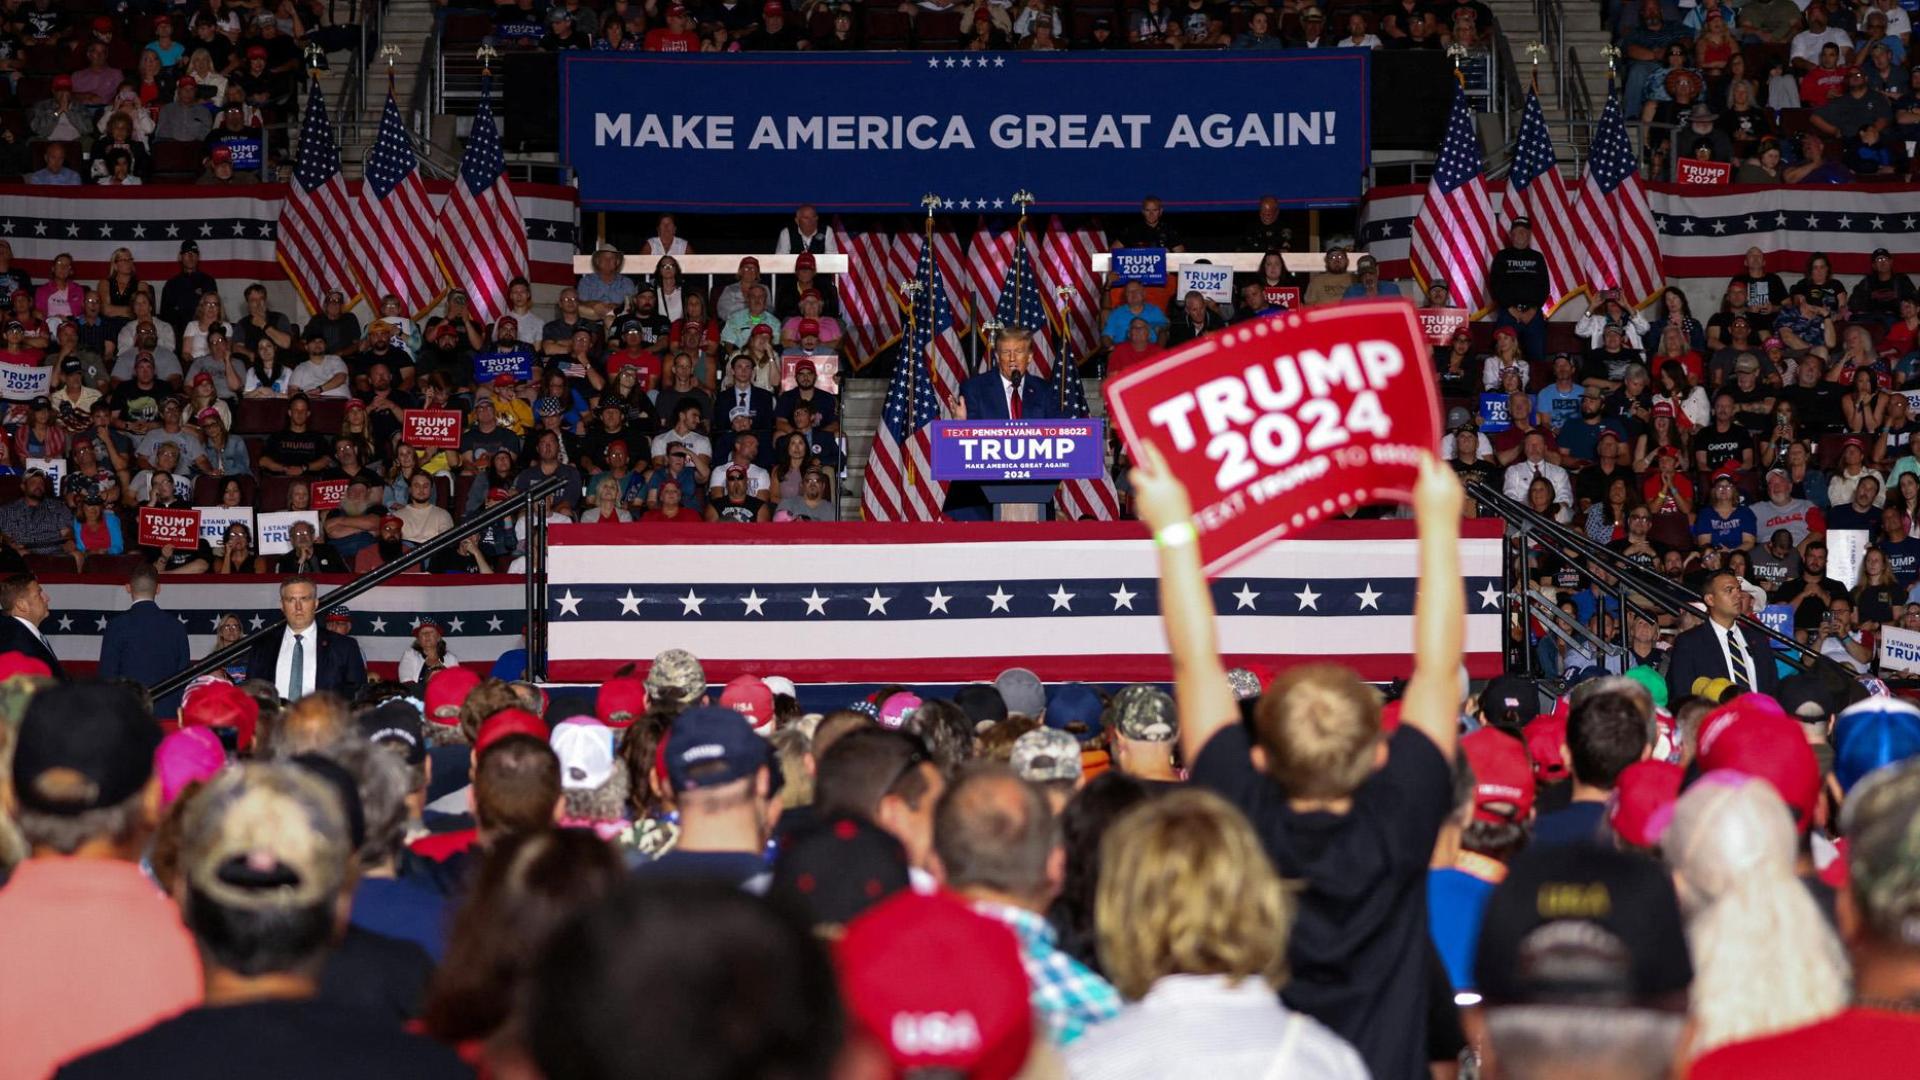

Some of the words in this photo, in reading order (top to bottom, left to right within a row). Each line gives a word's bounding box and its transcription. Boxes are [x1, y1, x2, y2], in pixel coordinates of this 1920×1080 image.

[595, 112, 734, 150] MAKE
[748, 114, 975, 150] AMERICA
[989, 114, 1151, 149] GREAT
[1164, 111, 1336, 149] AGAIN!
[229, 144, 258, 153] UMP
[231, 152, 254, 160] 024
[1682, 165, 1725, 178] TRUMP
[1686, 175, 1718, 184] 2024
[1117, 255, 1161, 265] TRUMP
[1123, 265, 1156, 274] 2024
[1185, 271, 1227, 281] TRUMP
[1190, 281, 1220, 290] 2024
[1265, 292, 1295, 301] UMP
[1419, 315, 1464, 325] TRUMP
[1425, 324, 1456, 334] 2024
[480, 356, 525, 367] TRUMP
[487, 364, 519, 373] 2024
[2, 370, 46, 381] TRUMP
[7, 380, 39, 390] 2024
[1148, 339, 1405, 453] TRUMP
[1486, 400, 1509, 411] TRU
[1491, 411, 1510, 420] 20
[409, 417, 456, 427] TRUMP
[415, 426, 449, 436] 2024
[947, 429, 970, 437] TEXT
[972, 428, 1042, 437] PENNSYLVANIA
[1044, 428, 1056, 436] TO
[1059, 427, 1087, 435] 88022
[1205, 389, 1393, 492] 2024
[959, 438, 1075, 461] TRUMP
[1708, 442, 1738, 451] George
[1332, 445, 1368, 469] TO
[1004, 471, 1030, 479] 2024
[145, 514, 194, 527] TRUMP
[151, 525, 187, 536] 2024
[200, 526, 227, 535] TRU
[264, 532, 290, 542] TRU
[1889, 556, 1916, 567] UMP
[1753, 565, 1788, 577] TRUMP
[1758, 613, 1788, 624] UMP
[1891, 640, 1914, 650] STAND
[733, 702, 753, 712] USA
